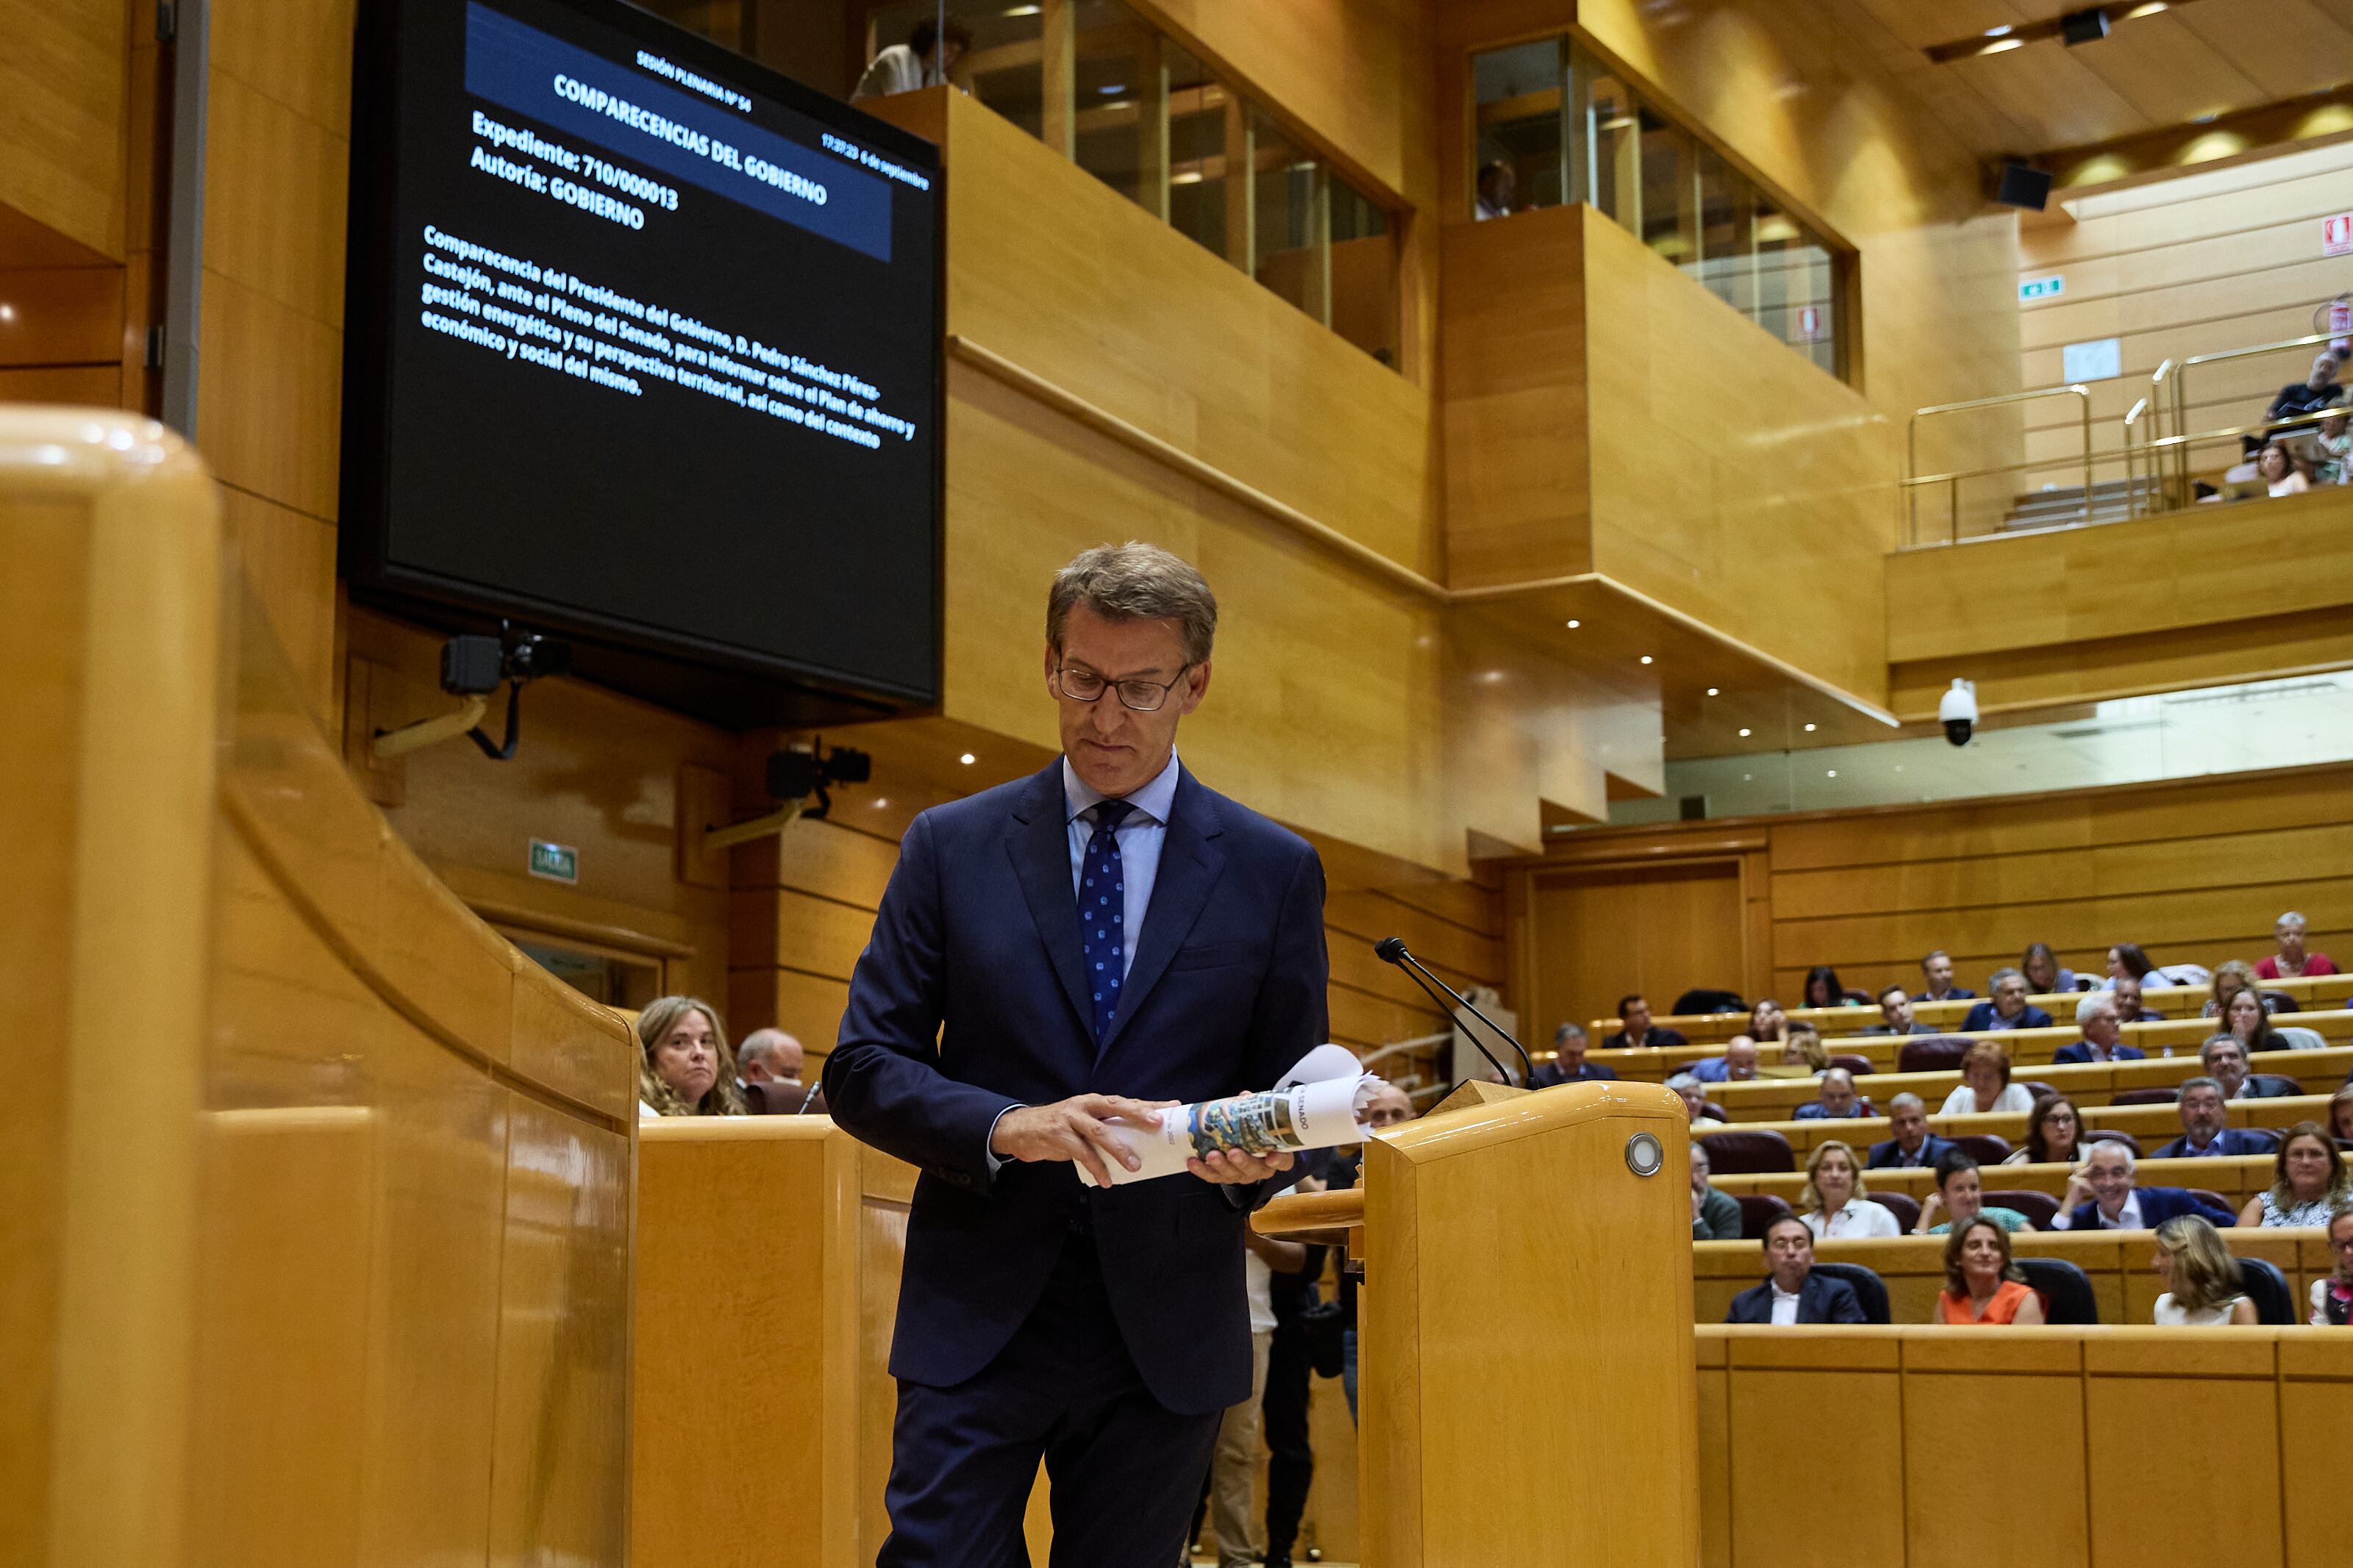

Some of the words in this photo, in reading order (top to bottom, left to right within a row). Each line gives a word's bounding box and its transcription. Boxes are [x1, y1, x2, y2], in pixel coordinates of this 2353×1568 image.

[637, 51, 675, 79] SESIÓN
[675, 68, 725, 101] PLENARIA
[738, 95, 751, 112] 54
[473, 111, 579, 172] Expediente:
[582, 154, 678, 210] 710/000013
[554, 74, 709, 156] COMPARECENCIAS
[712, 140, 743, 171] DEL
[744, 155, 826, 205] GOBIERNO
[860, 150, 869, 165] 6
[868, 153, 881, 170] de
[880, 160, 929, 190] septiembre
[471, 146, 547, 193] Autoría:
[550, 177, 644, 229] GOBIERNO
[424, 225, 540, 282] Comparecencia
[543, 268, 566, 291] del
[568, 276, 645, 318] Presidente
[646, 305, 668, 327] del
[670, 313, 735, 353] Gobierno,
[736, 336, 751, 356] D.
[752, 342, 790, 369] Pedro
[790, 356, 841, 388] Sánchez
[424, 253, 495, 296] Castejón,
[497, 282, 533, 306] ante
[535, 293, 549, 312] el
[551, 297, 593, 326] Pleno
[594, 312, 617, 335] del
[619, 321, 674, 357] Senado,
[675, 343, 707, 366] para
[709, 351, 768, 386] informar
[768, 375, 804, 399] sobre
[804, 387, 818, 404] el
[818, 390, 846, 414] Plan
[847, 401, 864, 420] de
[864, 407, 905, 434] ahorro
[904, 422, 915, 441] y
[421, 311, 506, 351] económico
[507, 339, 518, 359] y
[520, 343, 563, 370] social
[564, 355, 588, 379] del
[590, 366, 642, 395] mismo.
[421, 283, 480, 316] gestión
[482, 304, 561, 343] energética
[563, 330, 574, 351] y
[575, 335, 593, 354] su
[595, 341, 676, 381] perspectiva
[677, 367, 746, 407] territorial,
[748, 393, 768, 412] así
[768, 400, 804, 423] como
[804, 410, 825, 431] del
[826, 420, 880, 448] contexto
[1298, 1095, 1309, 1130] SENADO
